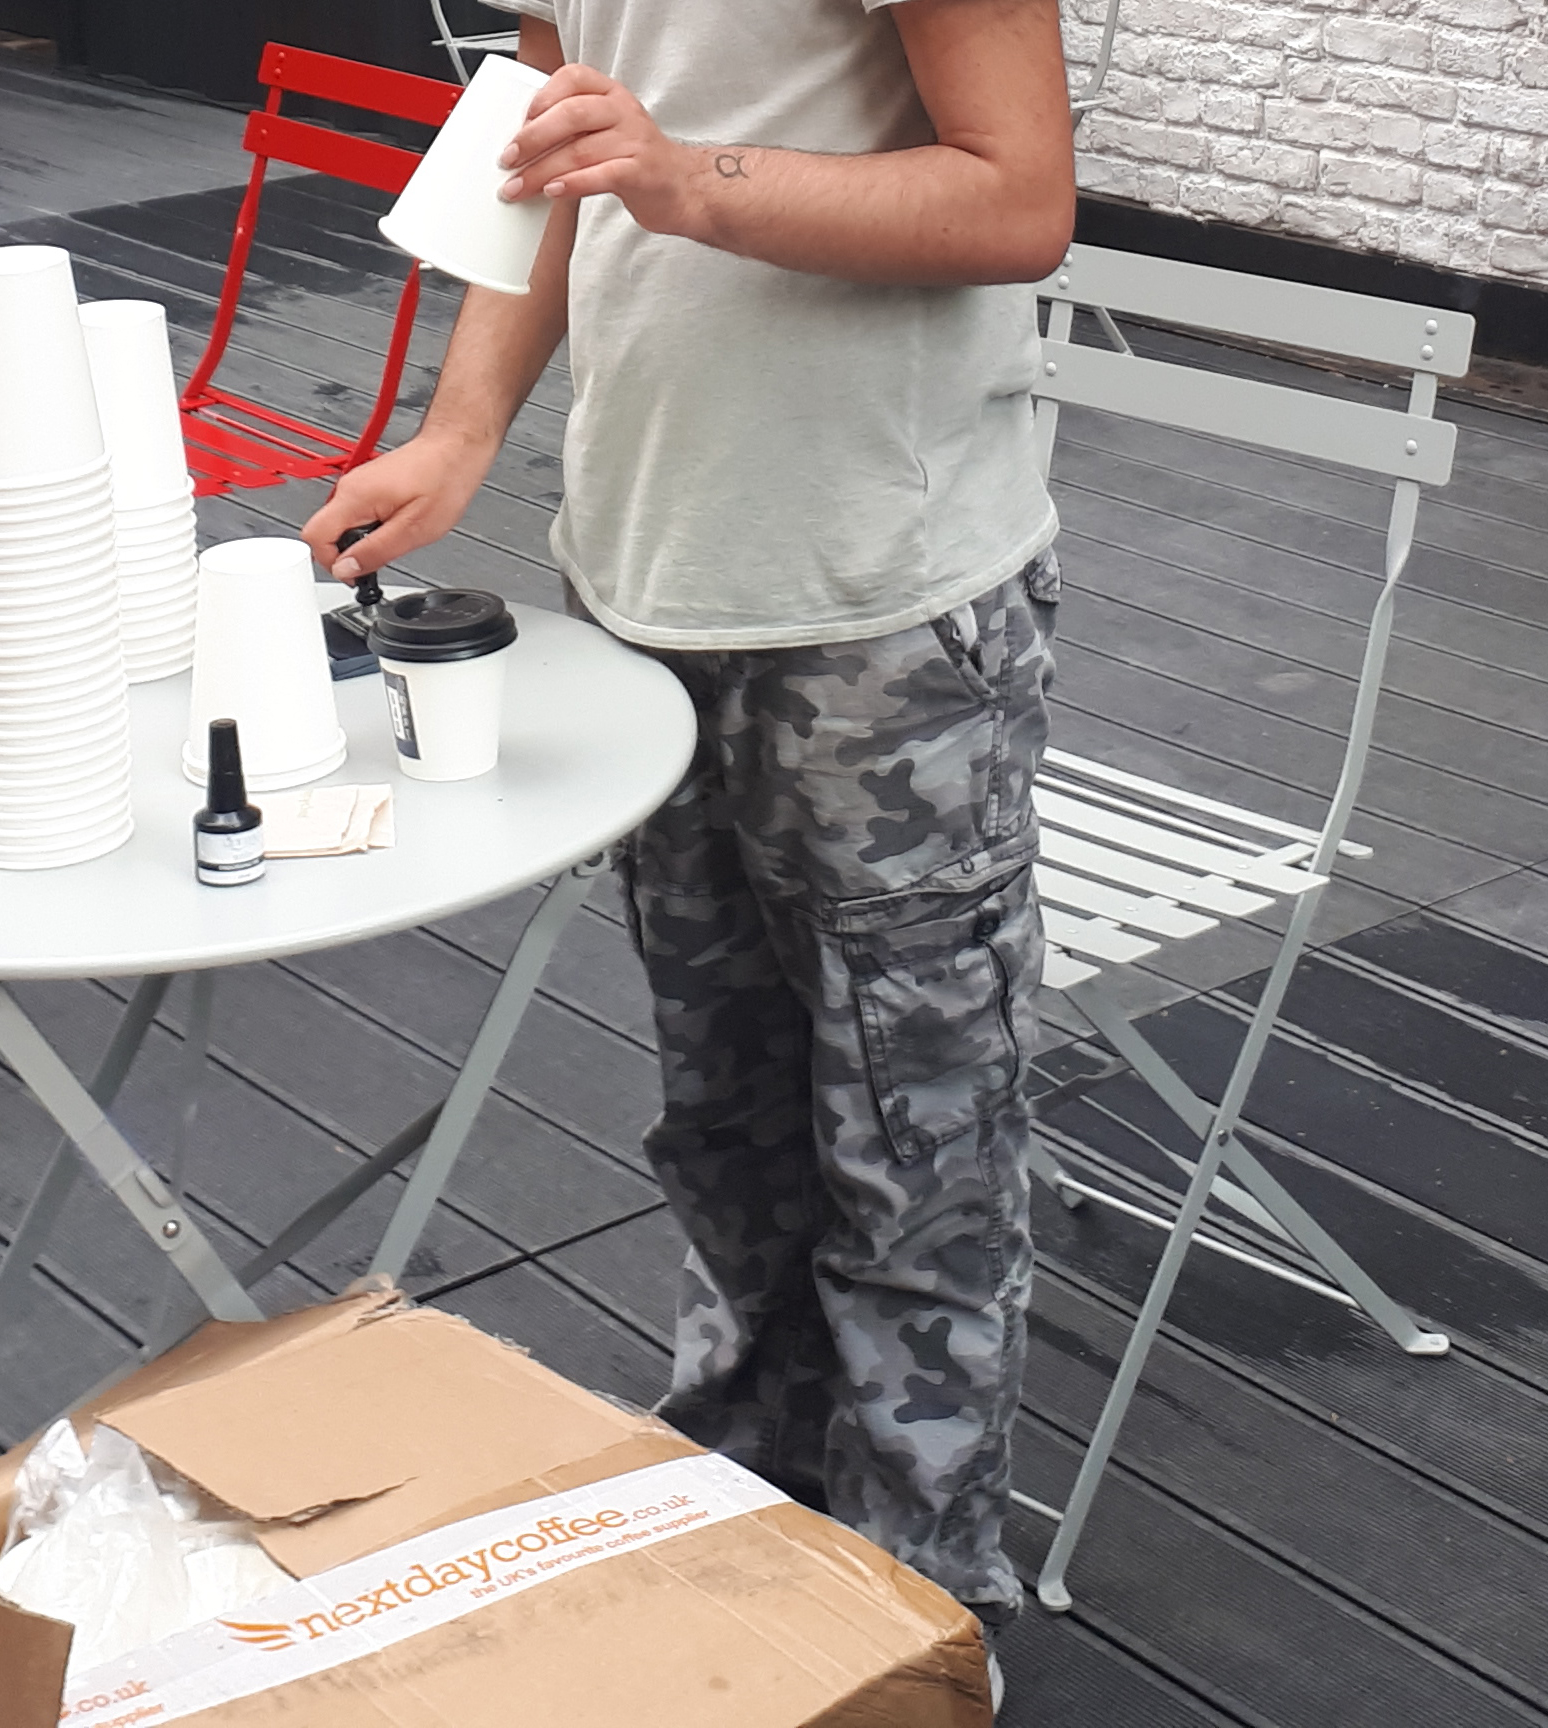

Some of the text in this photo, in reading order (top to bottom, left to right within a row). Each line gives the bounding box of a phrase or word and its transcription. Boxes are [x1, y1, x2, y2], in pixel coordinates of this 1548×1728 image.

[297, 1494, 695, 1639] nextdaycoffee.co.uk
[470, 1509, 711, 1598] the UK's favourite coffee supplier
